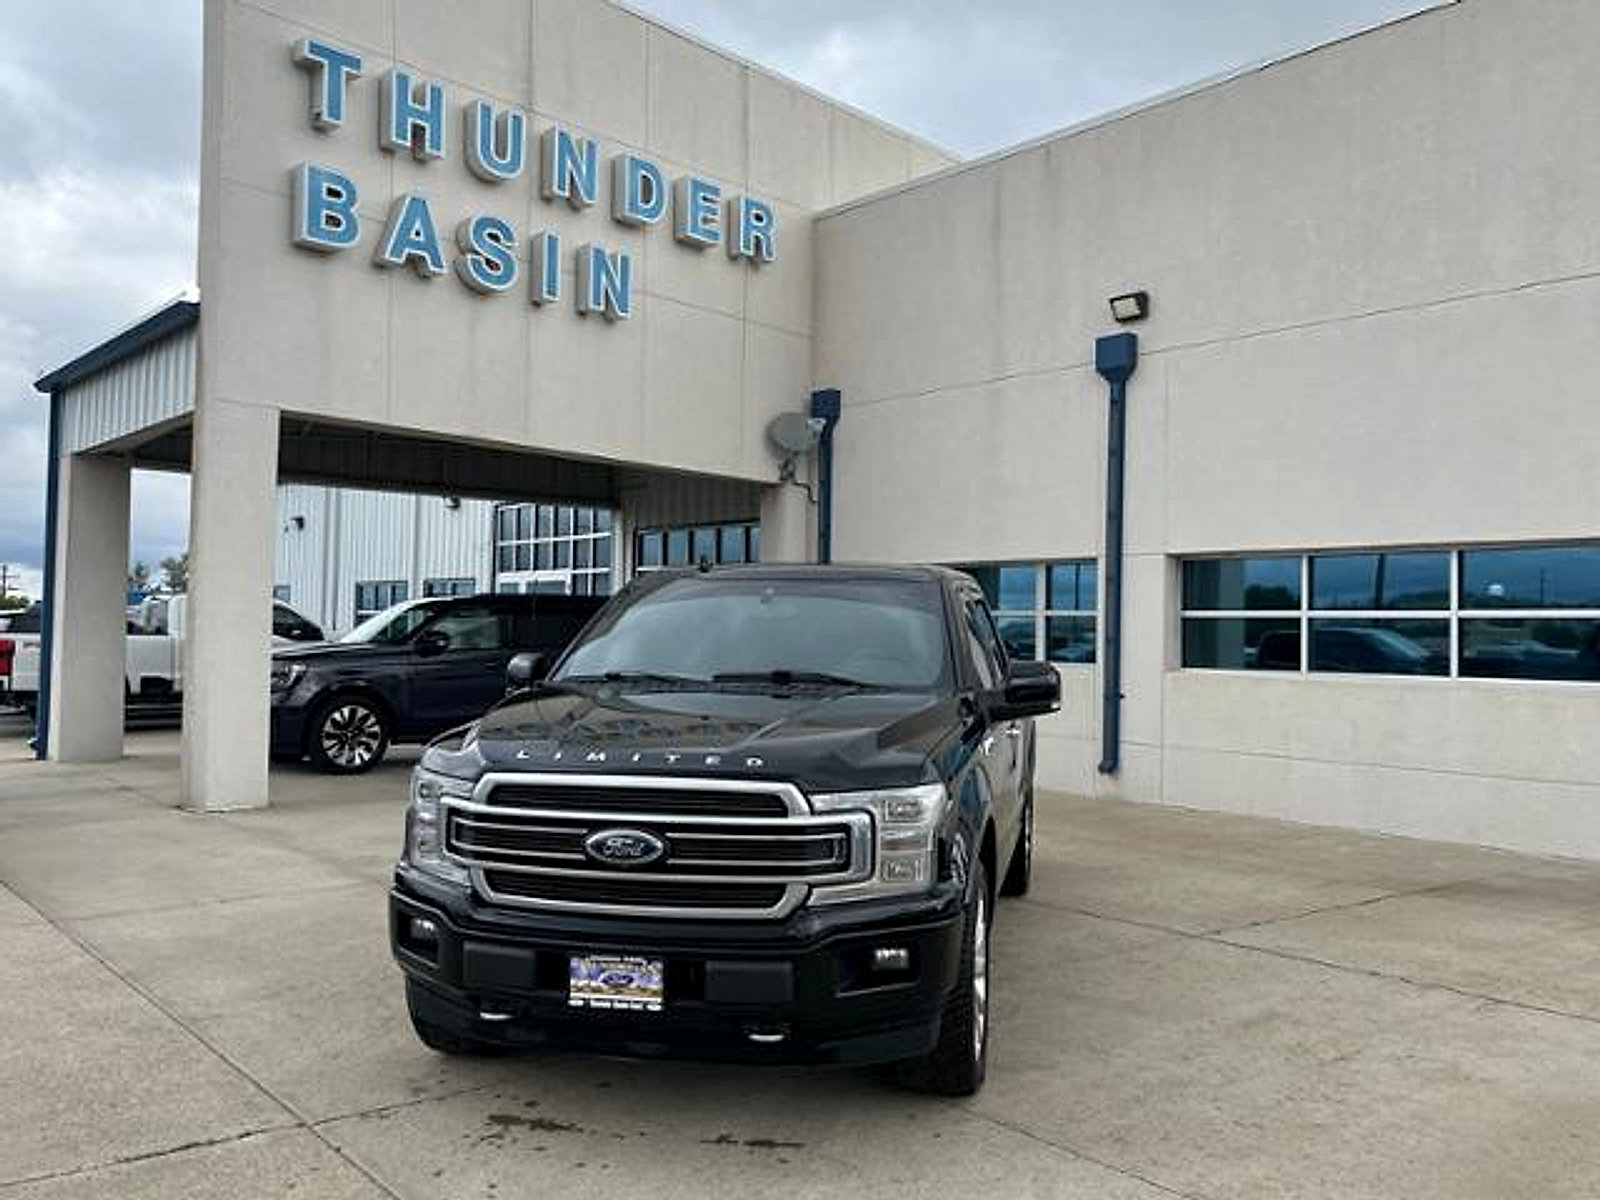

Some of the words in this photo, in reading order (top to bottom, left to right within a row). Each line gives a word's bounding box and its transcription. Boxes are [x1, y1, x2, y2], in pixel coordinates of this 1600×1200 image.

[295, 38, 778, 264] THUNDER
[292, 160, 634, 321] BASIN
[516, 749, 764, 768] LIMITED
[602, 837, 646, 858] Ford
